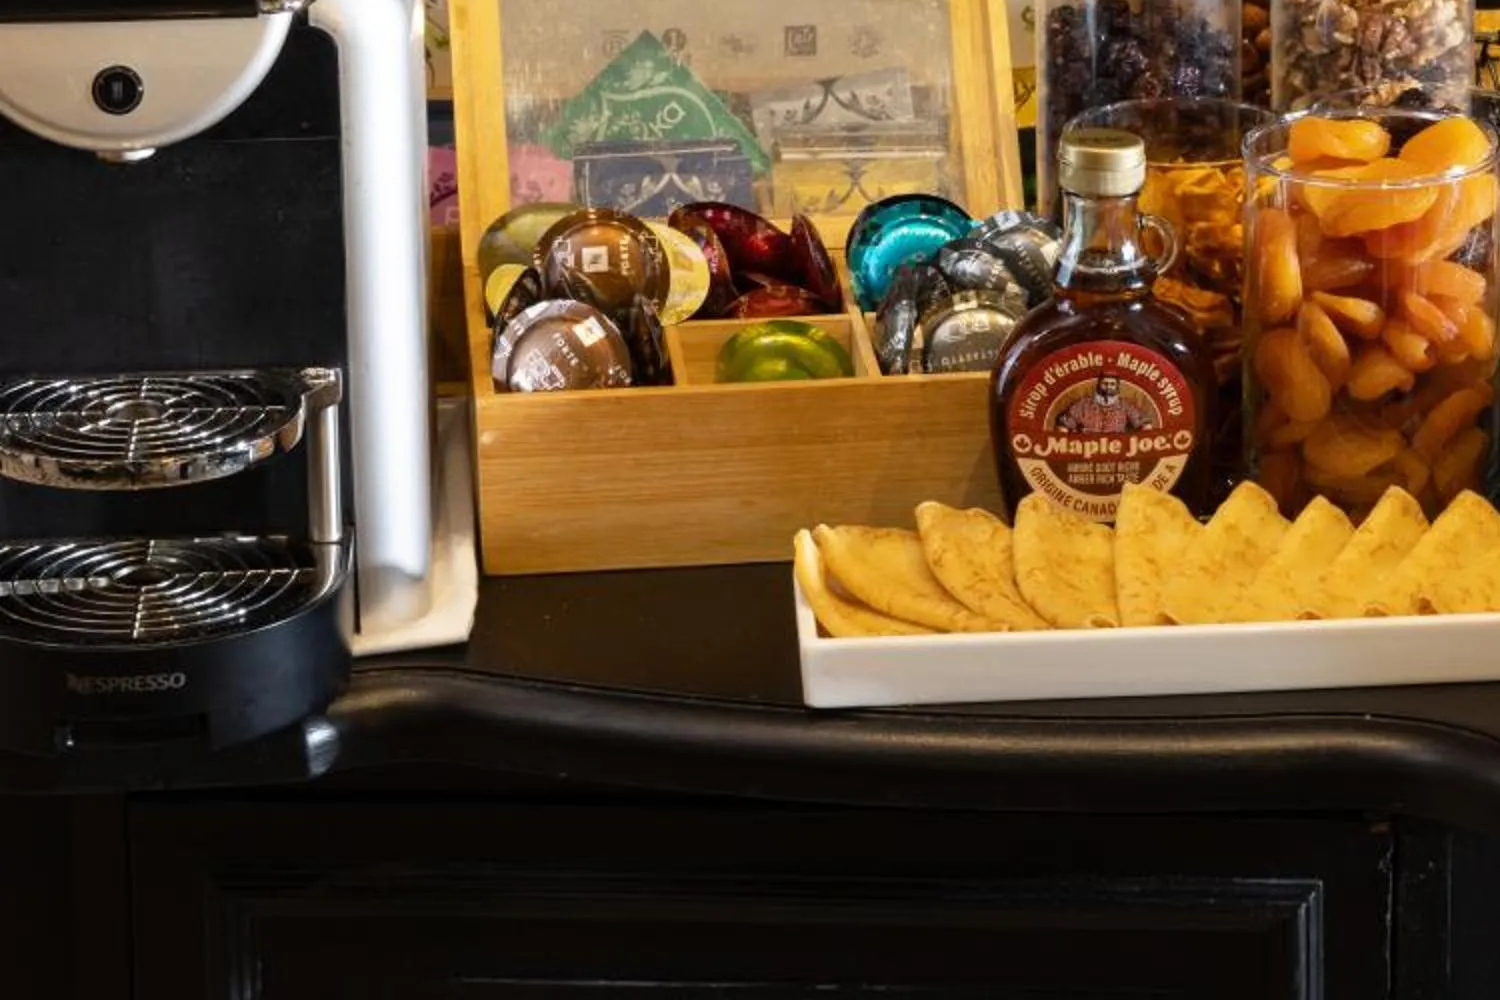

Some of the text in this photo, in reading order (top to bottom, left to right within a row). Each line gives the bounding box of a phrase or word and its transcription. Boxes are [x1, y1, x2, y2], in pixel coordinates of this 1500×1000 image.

[1019, 352, 1184, 419] Sirop d'érable Maple syrup
[1033, 436, 1123, 459] Maple
[1030, 467, 1071, 507] ORIGINE
[1073, 500, 1118, 515] CANAD
[65, 672, 187, 695] NESPRESSO
